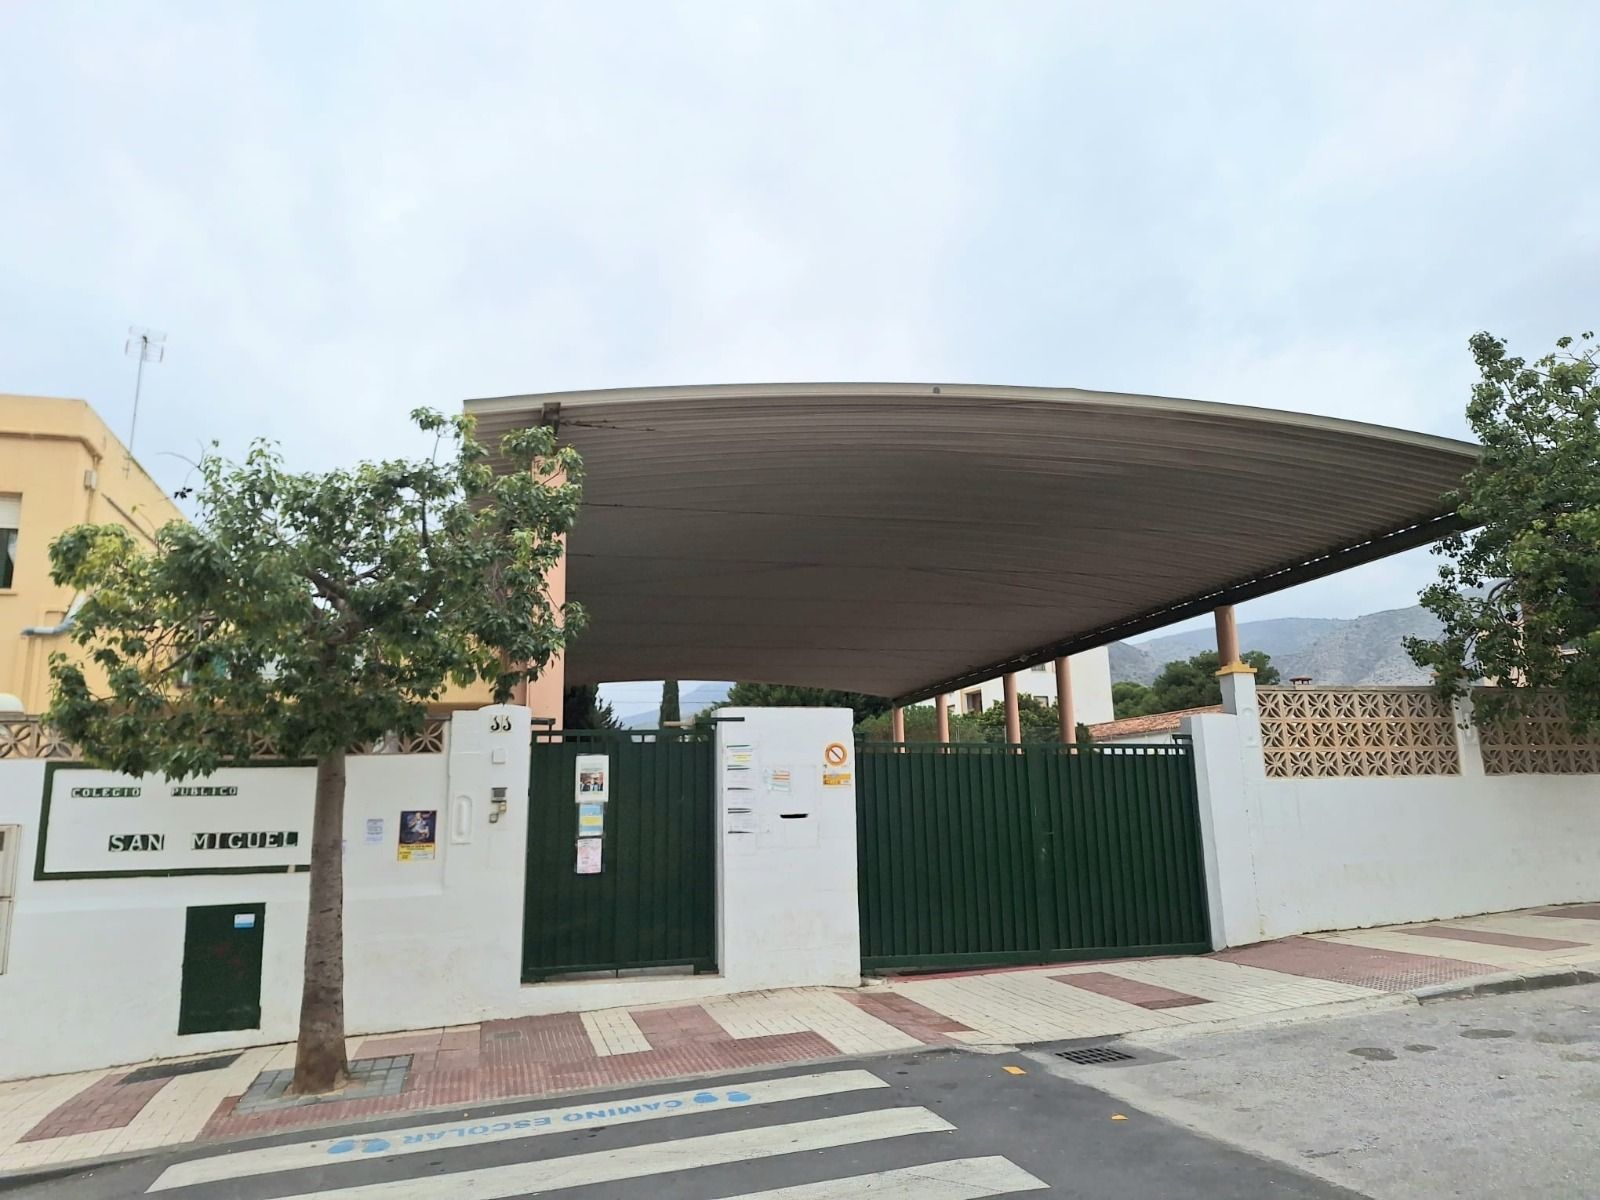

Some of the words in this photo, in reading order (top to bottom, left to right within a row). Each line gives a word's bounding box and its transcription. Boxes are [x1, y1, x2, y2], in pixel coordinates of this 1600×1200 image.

[71, 787, 141, 798] COLEGIO
[171, 786, 238, 797] PUBLICO
[109, 833, 164, 851] SAN
[191, 831, 299, 850] MIGUEL
[563, 1100, 683, 1122] CAMINO
[403, 1116, 552, 1145] ESCOLAR
